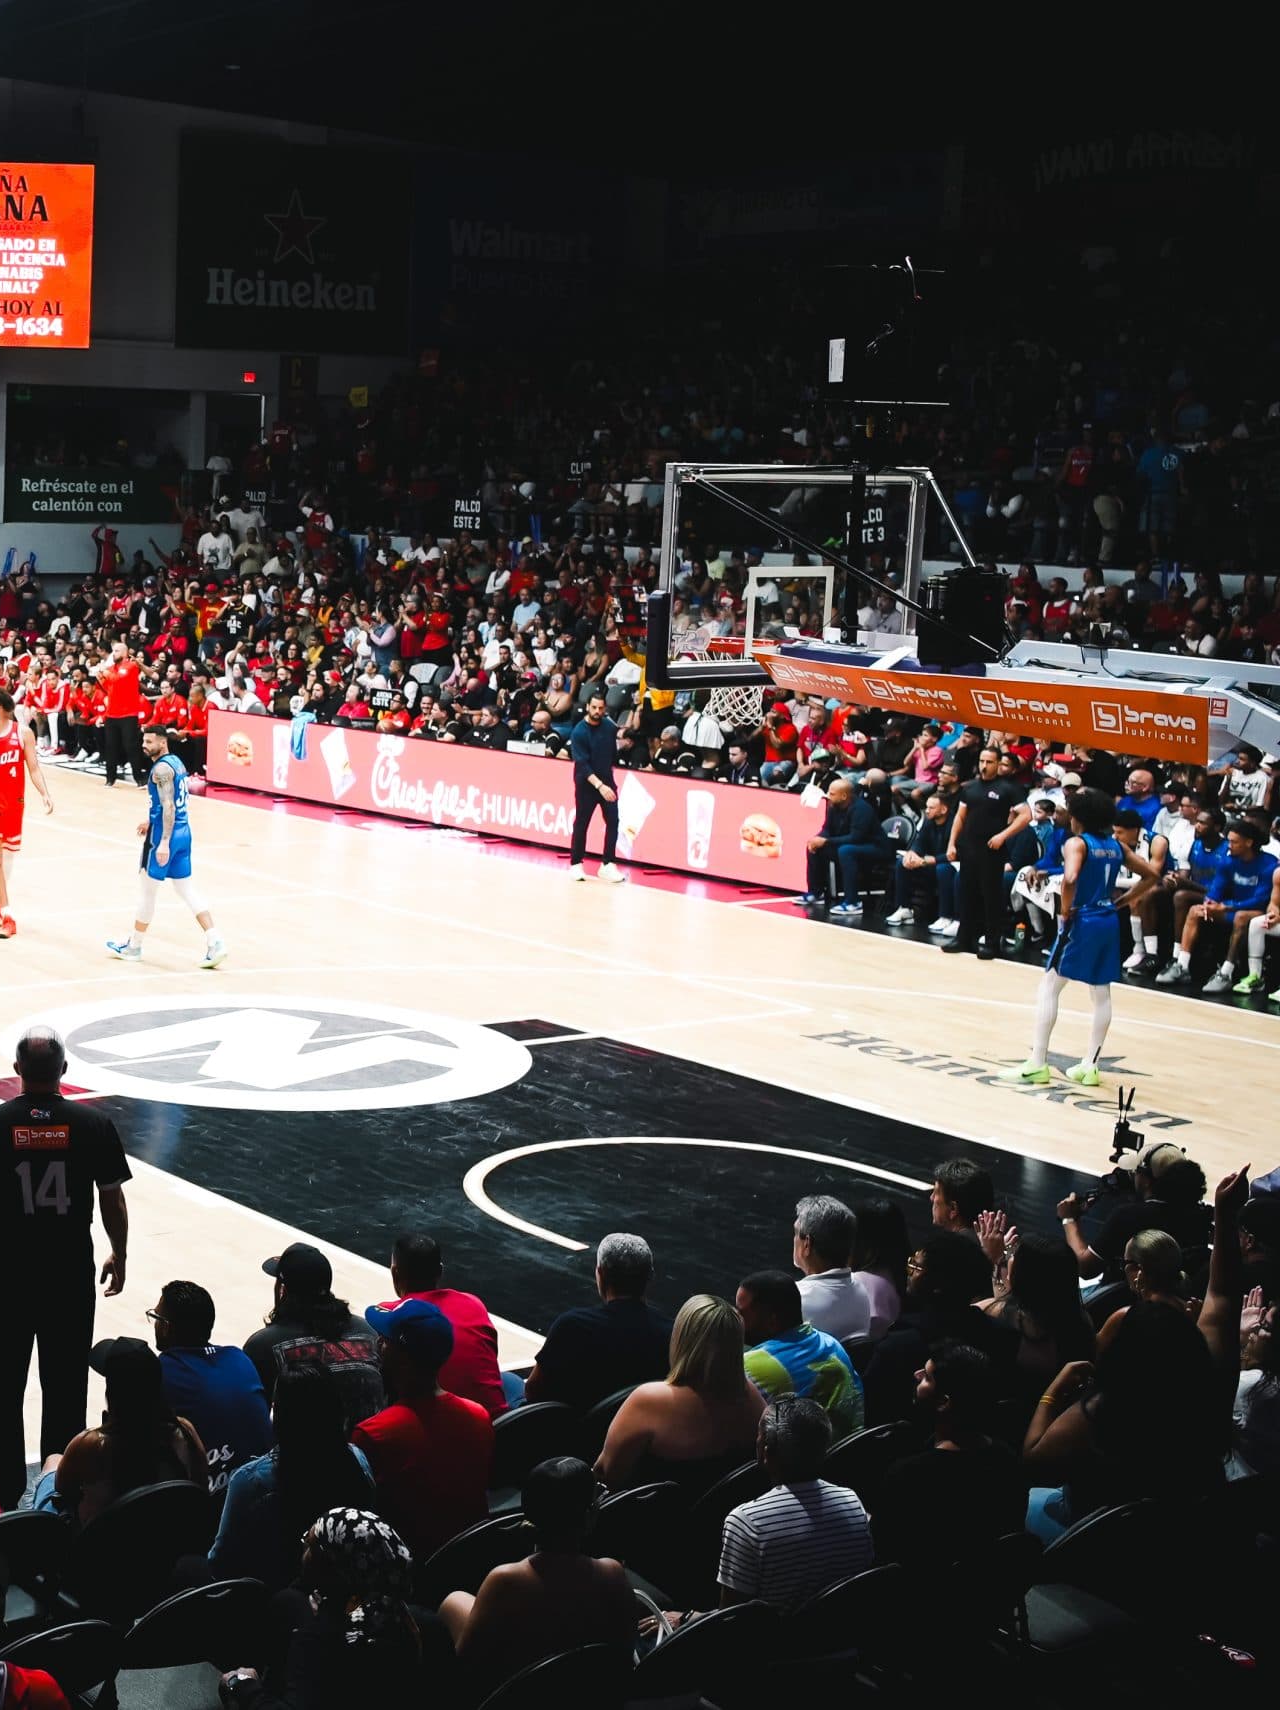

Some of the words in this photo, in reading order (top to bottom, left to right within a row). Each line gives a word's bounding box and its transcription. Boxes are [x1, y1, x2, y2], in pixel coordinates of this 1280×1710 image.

[38, 238, 56, 252] EN
[2, 252, 66, 267] LICENCIA
[206, 267, 376, 312] Heineken
[41, 301, 64, 316] AL
[21, 478, 96, 494] Refréscate
[100, 482, 118, 494] en
[120, 480, 134, 494] el
[32, 496, 94, 512] calentón
[97, 500, 123, 513] con
[454, 499, 481, 513] PALCO
[453, 515, 473, 529] ESTE
[474, 515, 481, 529] 2
[877, 526, 885, 542] 3
[790, 666, 848, 686] brava
[888, 681, 953, 701] brava
[896, 697, 958, 712] lubricants
[1000, 692, 1070, 716] brava
[1005, 711, 1071, 728] lubricants
[1123, 704, 1197, 731] brava
[1125, 726, 1197, 745] lubricants
[9, 766, 17, 777] 4
[31, 1129, 67, 1139] brava
[15, 1160, 72, 1216] 14
